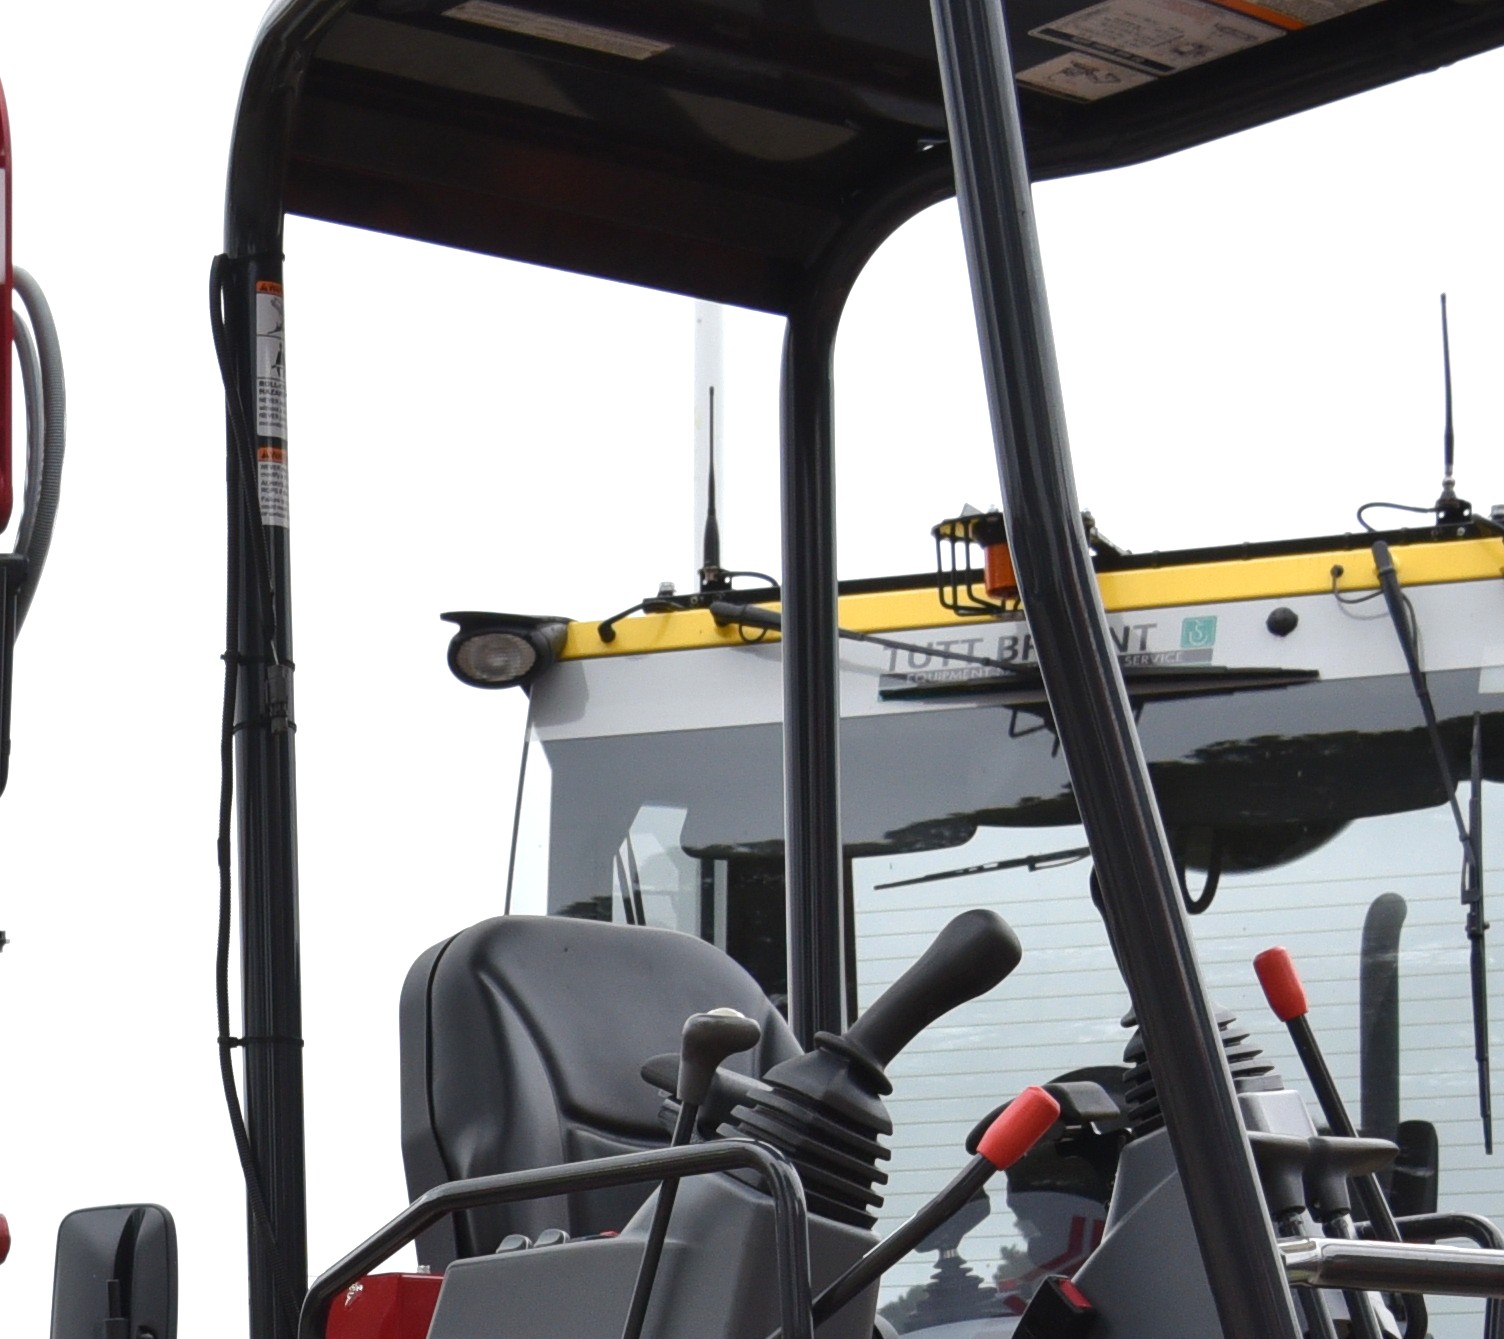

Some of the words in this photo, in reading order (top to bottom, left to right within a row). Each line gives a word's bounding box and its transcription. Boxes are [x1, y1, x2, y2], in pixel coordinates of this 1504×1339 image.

[883, 638, 984, 671] TUTT
[997, 623, 1158, 663] BRNT
[1125, 651, 1183, 666] SERVICE
